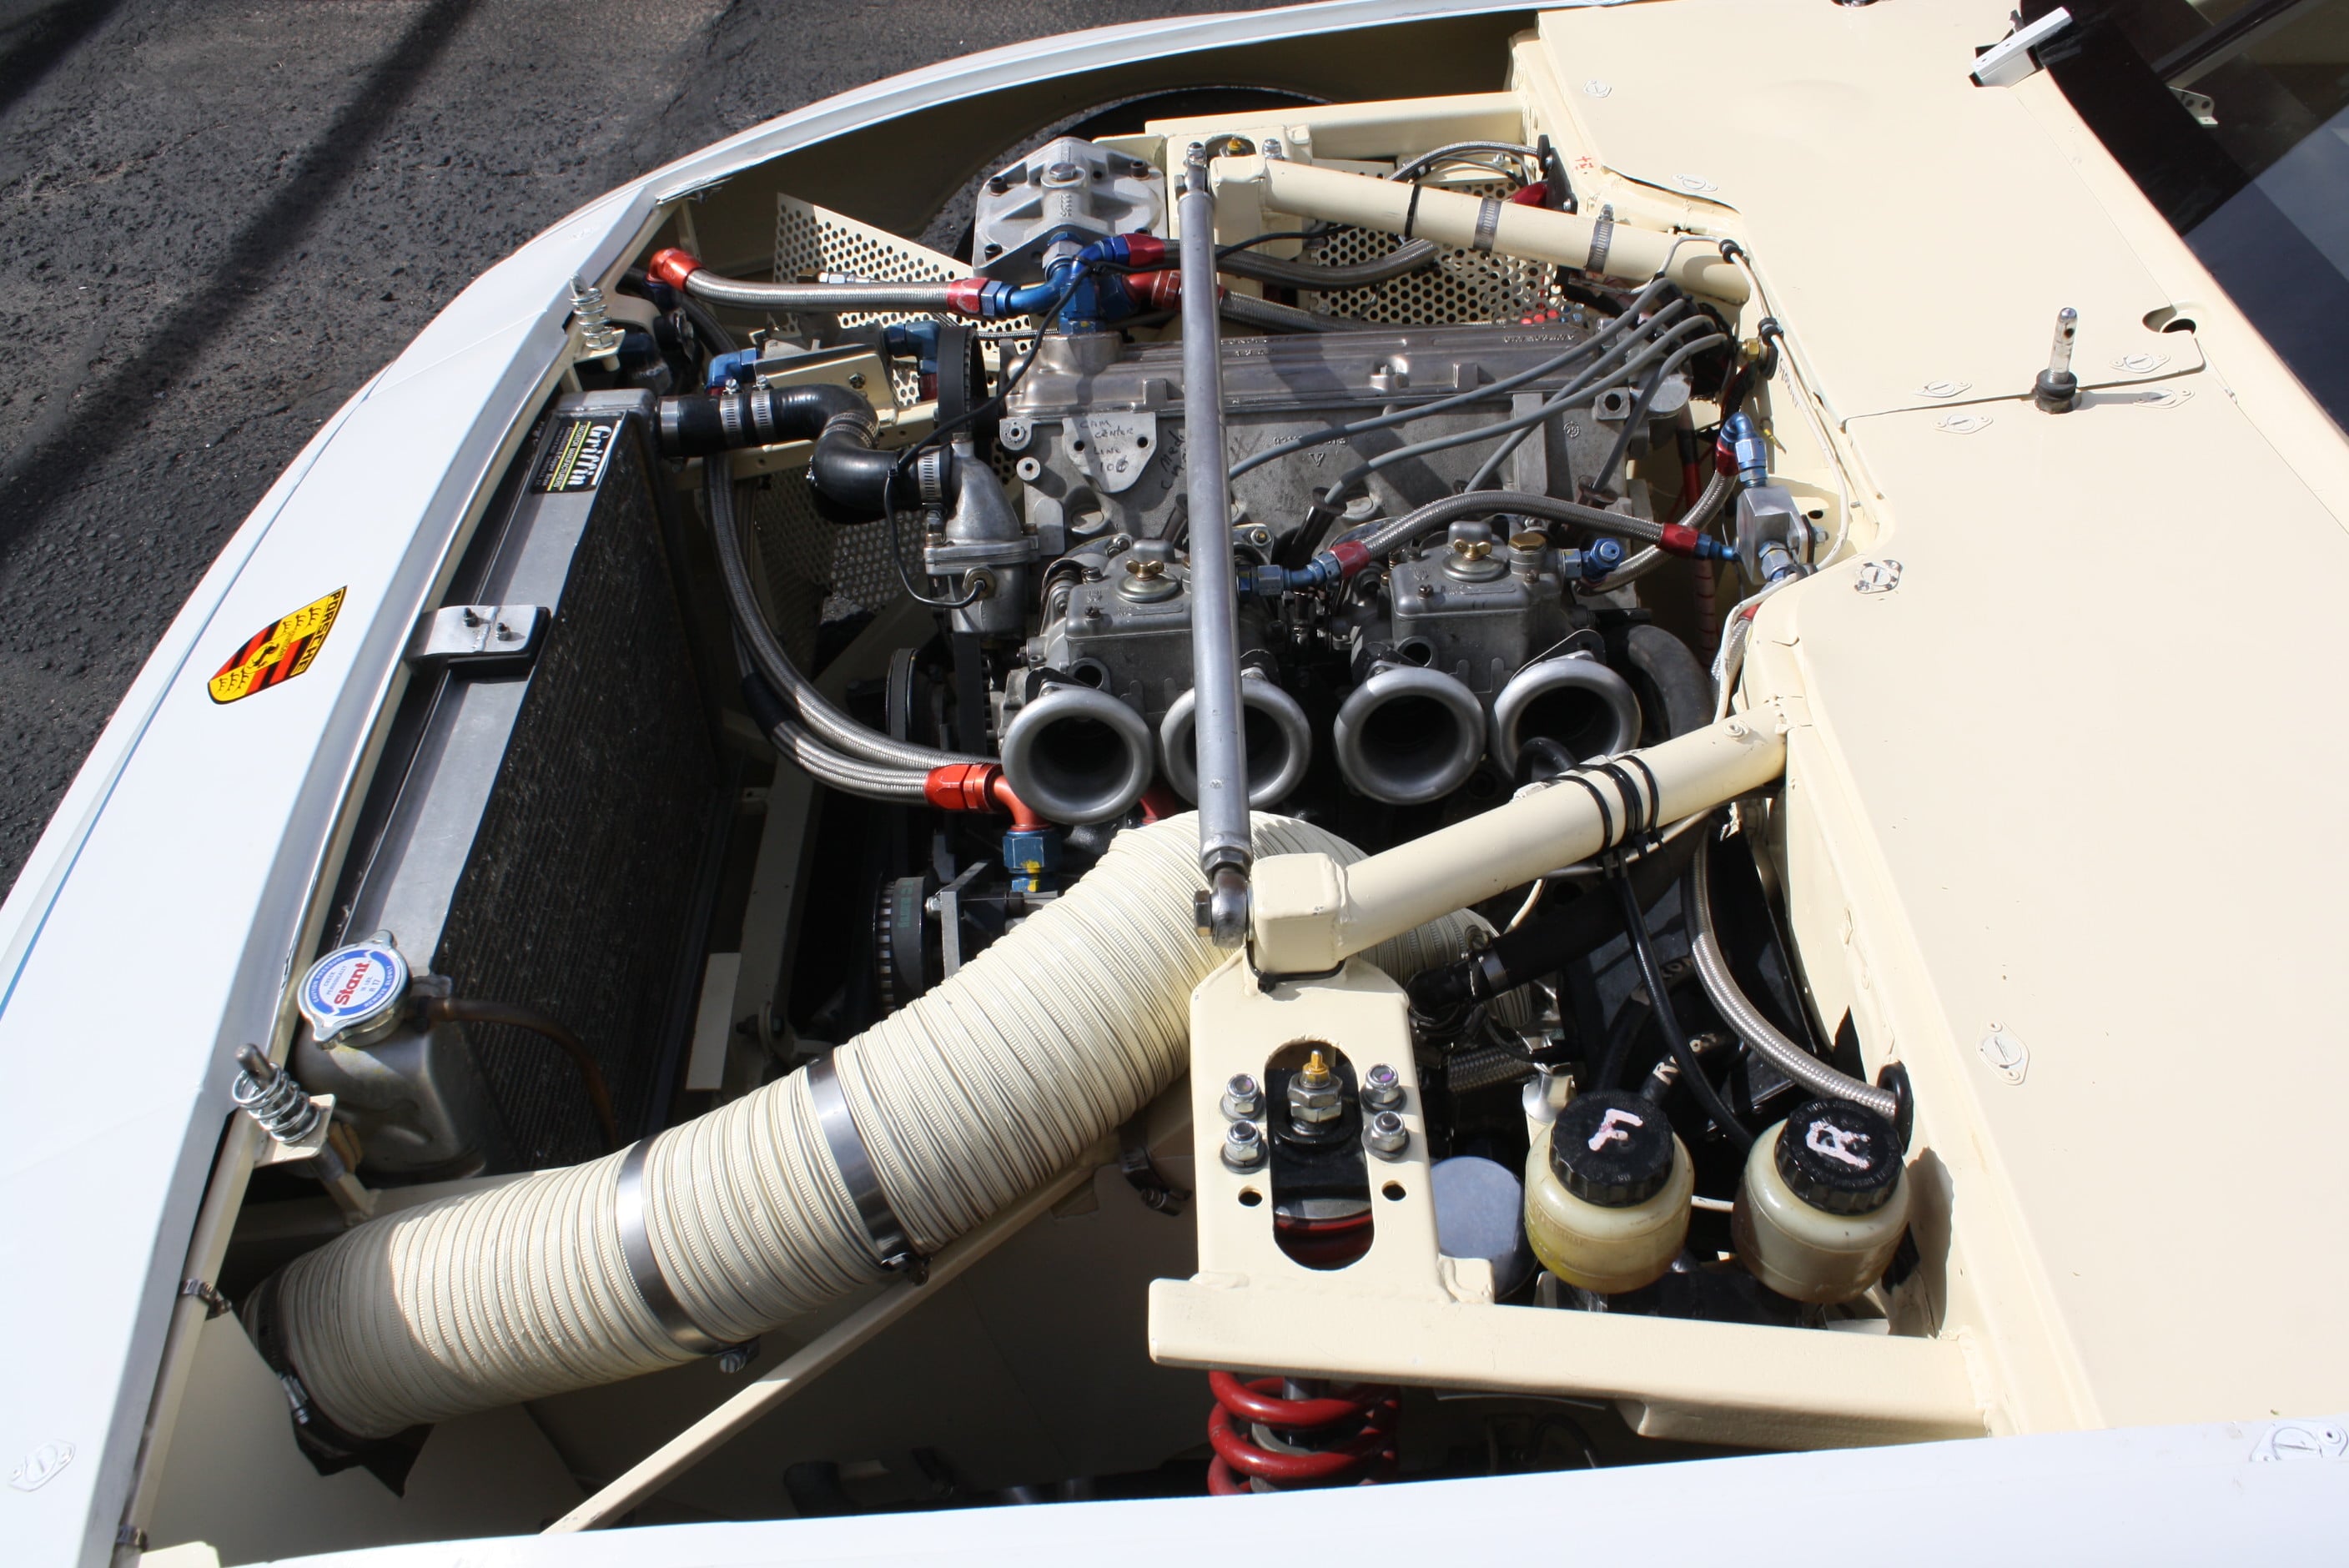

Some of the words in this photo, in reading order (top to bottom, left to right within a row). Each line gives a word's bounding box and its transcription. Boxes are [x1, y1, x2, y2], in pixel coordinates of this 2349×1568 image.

[1080, 419, 1111, 428] CAM
[567, 425, 611, 485] Griffin
[294, 591, 342, 674] PORSCHE
[334, 962, 370, 1006] Stant
[1588, 1108, 1643, 1151] F
[1805, 1120, 1870, 1169] R
